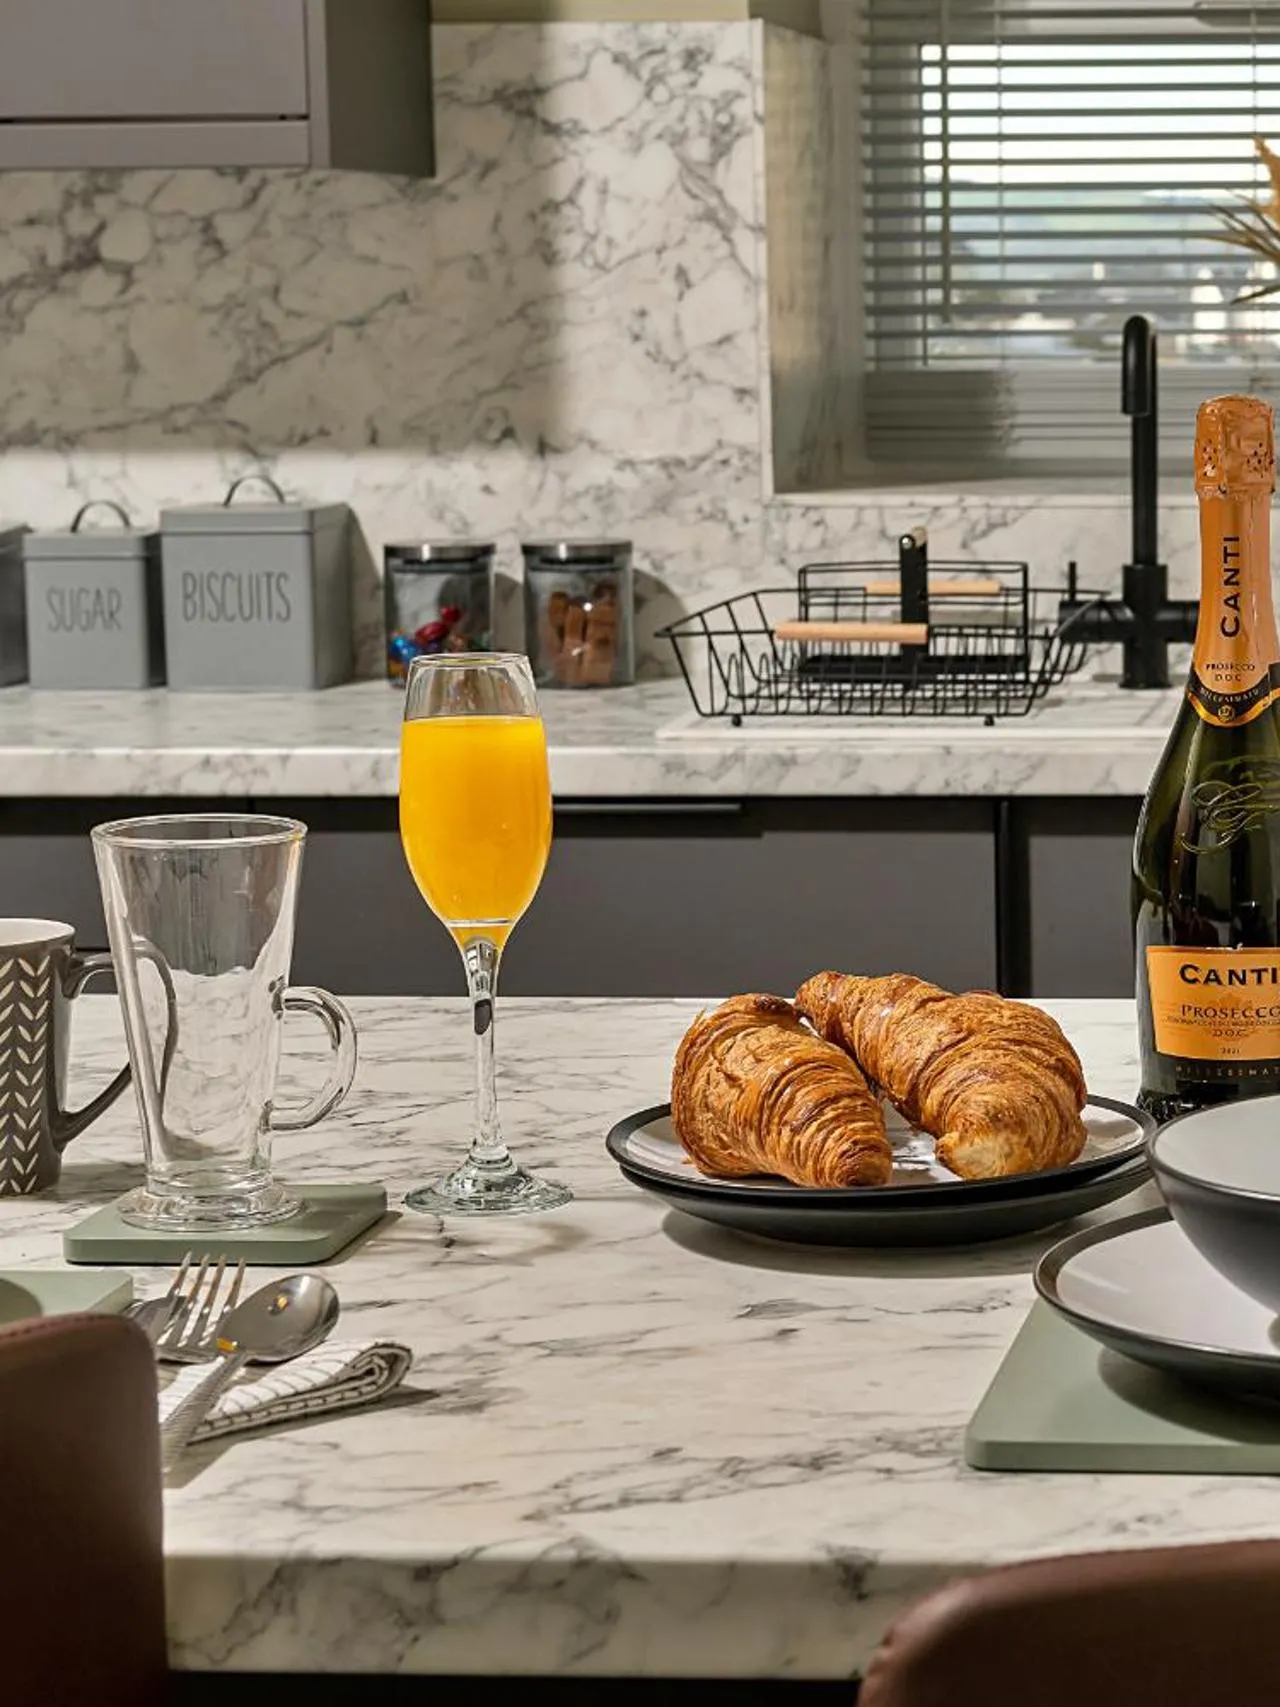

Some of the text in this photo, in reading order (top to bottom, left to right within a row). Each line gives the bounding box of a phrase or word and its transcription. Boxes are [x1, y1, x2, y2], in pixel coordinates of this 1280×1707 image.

[181, 570, 292, 625] BISCUITS
[1221, 535, 1240, 638] CANTI
[46, 587, 122, 634] SUGAR
[1205, 662, 1256, 672] PROSECCO
[1179, 964, 1278, 986] CANTI
